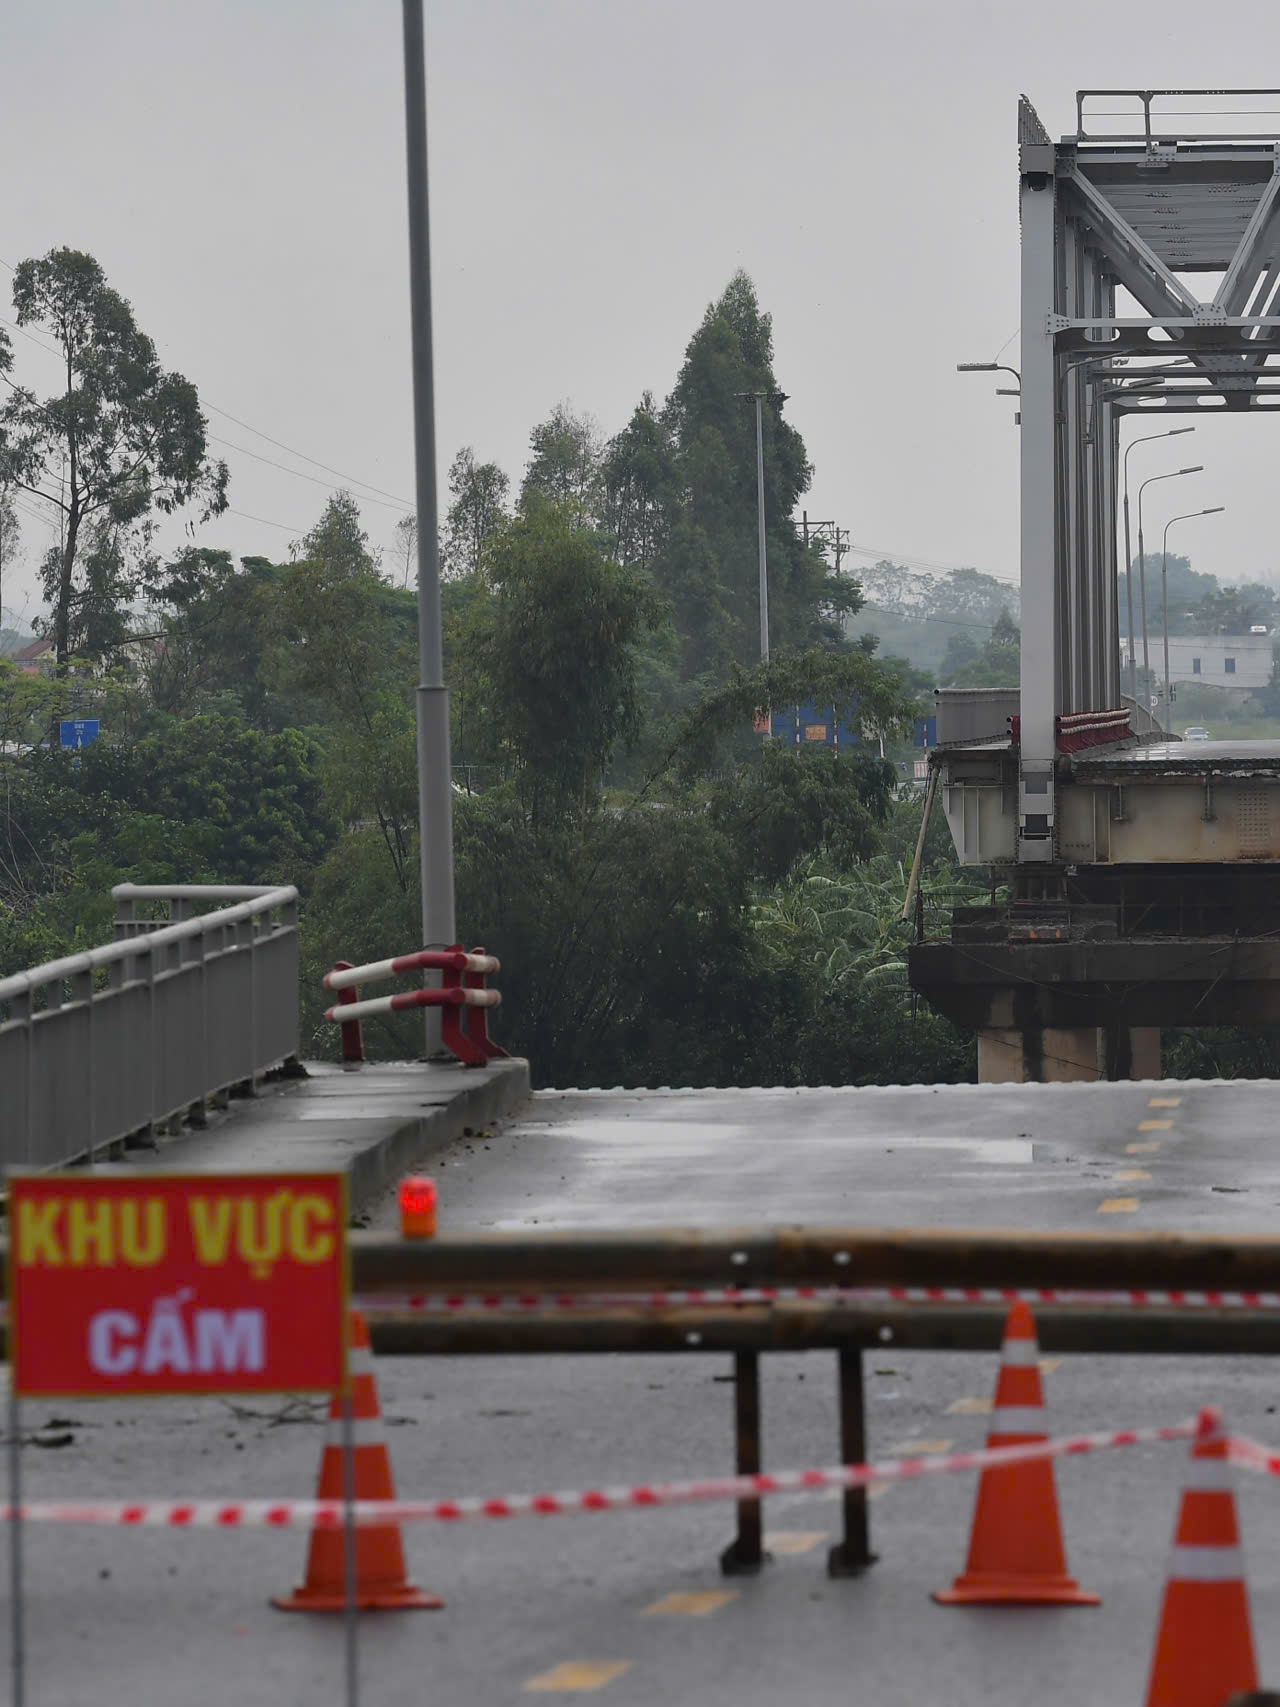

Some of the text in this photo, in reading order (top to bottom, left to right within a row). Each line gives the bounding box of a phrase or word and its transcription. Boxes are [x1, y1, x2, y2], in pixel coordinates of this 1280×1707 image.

[17, 1190, 333, 1279] KHU VỰC
[87, 1286, 266, 1376] CẤM
